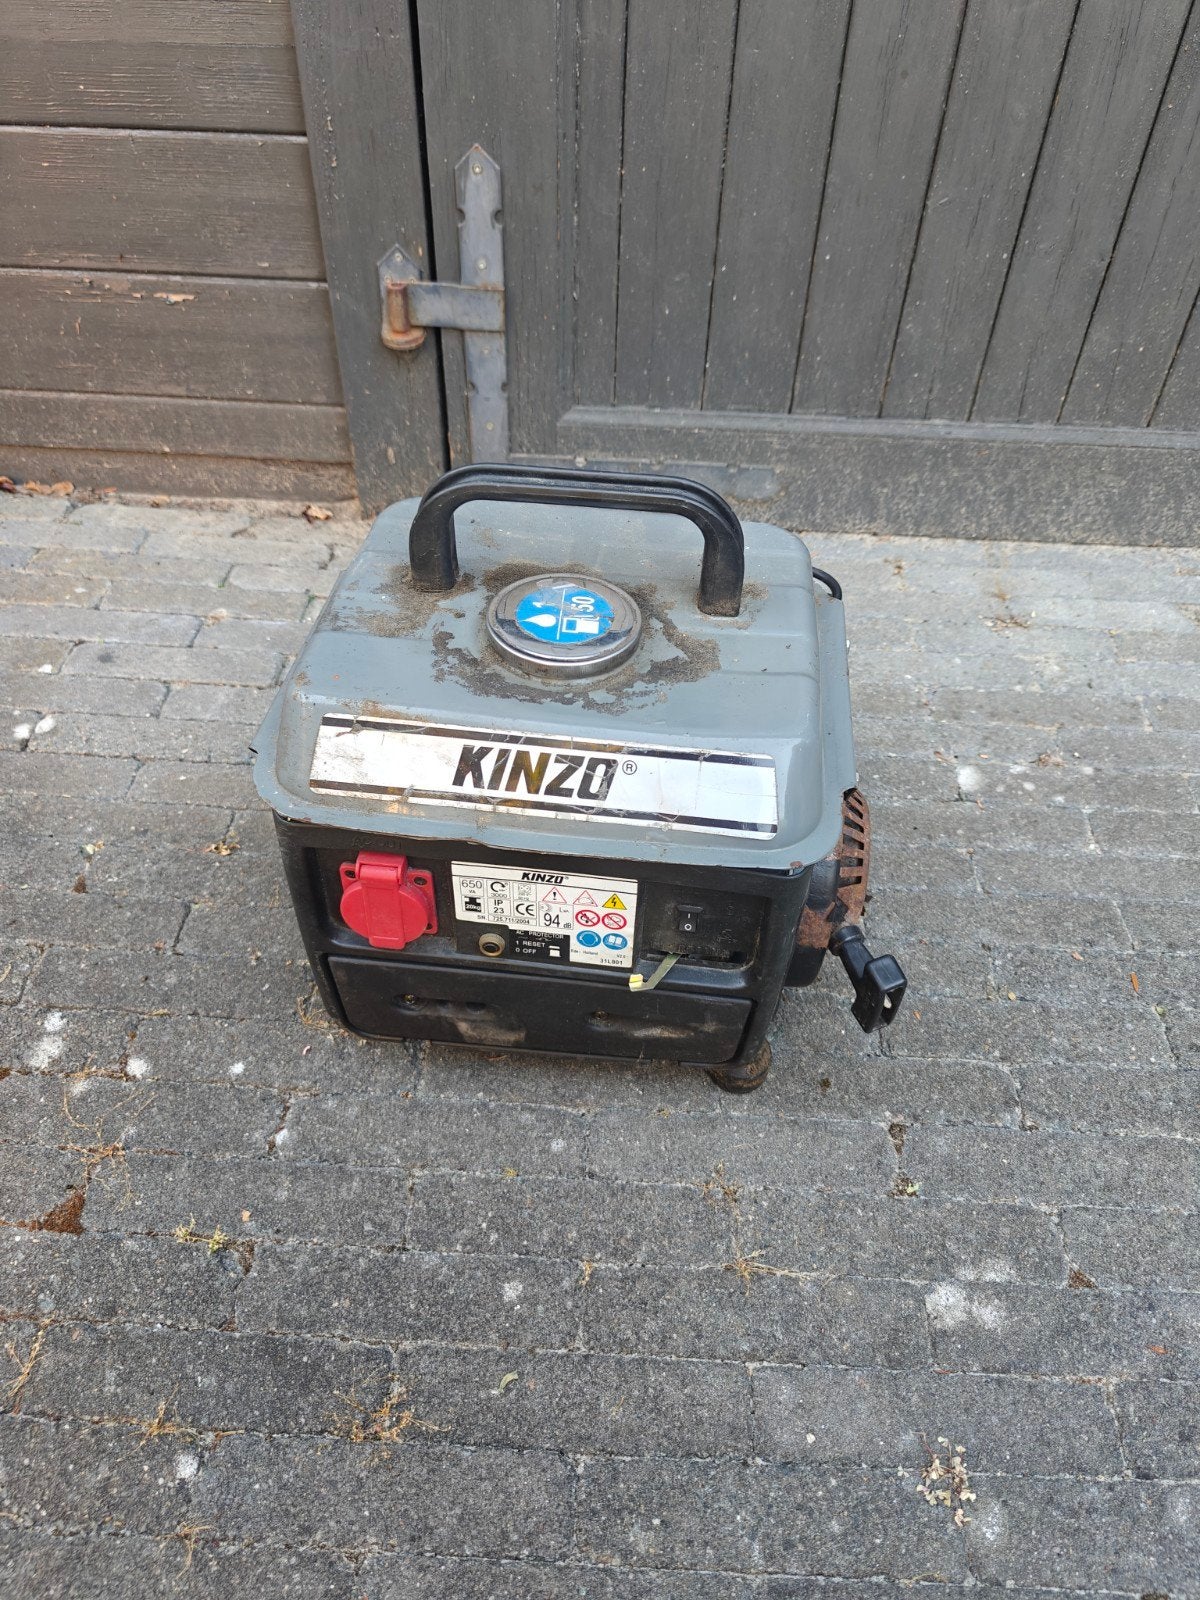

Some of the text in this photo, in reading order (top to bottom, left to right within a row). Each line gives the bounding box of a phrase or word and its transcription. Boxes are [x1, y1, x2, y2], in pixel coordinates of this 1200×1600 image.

[452, 743, 619, 802] KINZO
[521, 872, 564, 884] KINZO
[461, 879, 482, 889] 650
[493, 906, 504, 914] 23
[543, 912, 560, 927] 94
[528, 930, 564, 939] PROTECTOR
[522, 940, 546, 948] RESET
